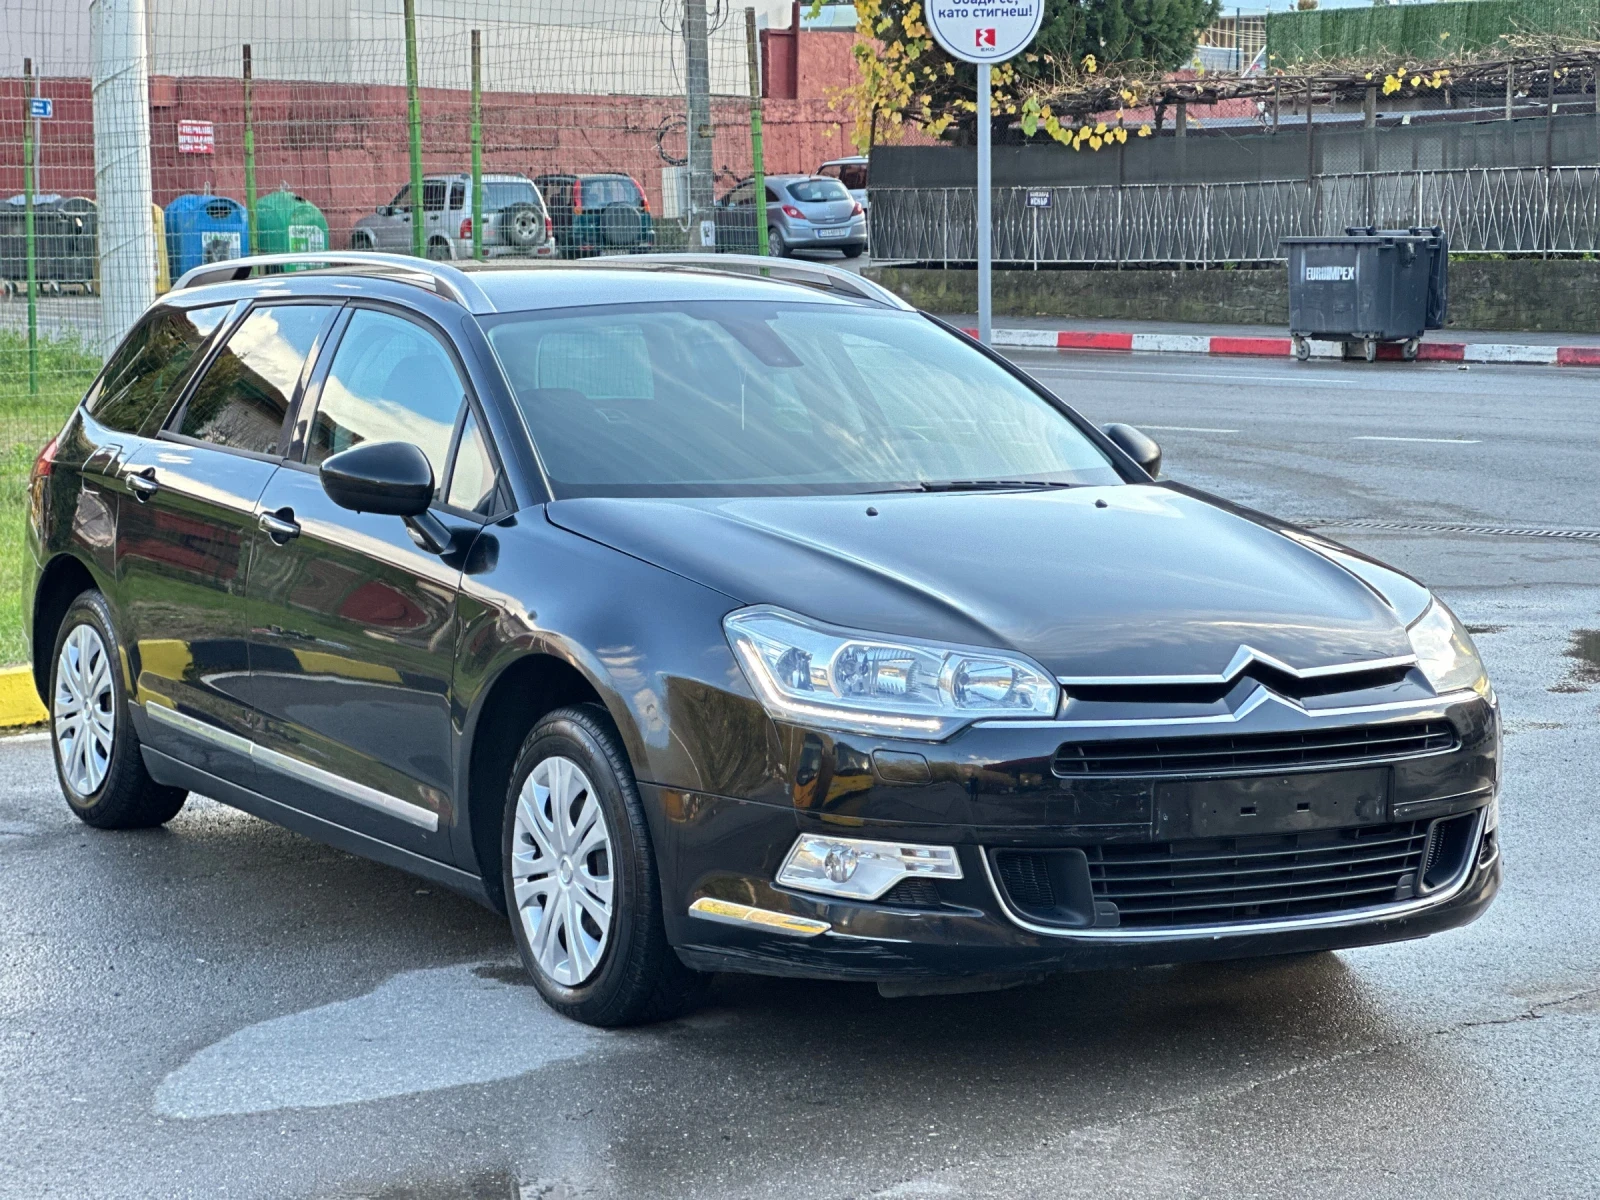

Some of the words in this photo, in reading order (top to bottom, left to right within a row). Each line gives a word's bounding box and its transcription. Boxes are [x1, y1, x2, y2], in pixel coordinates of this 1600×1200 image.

[938, 8, 969, 18] като
[972, 4, 1033, 17] стигнеш!
[1306, 266, 1355, 280] EUROIMPEX
